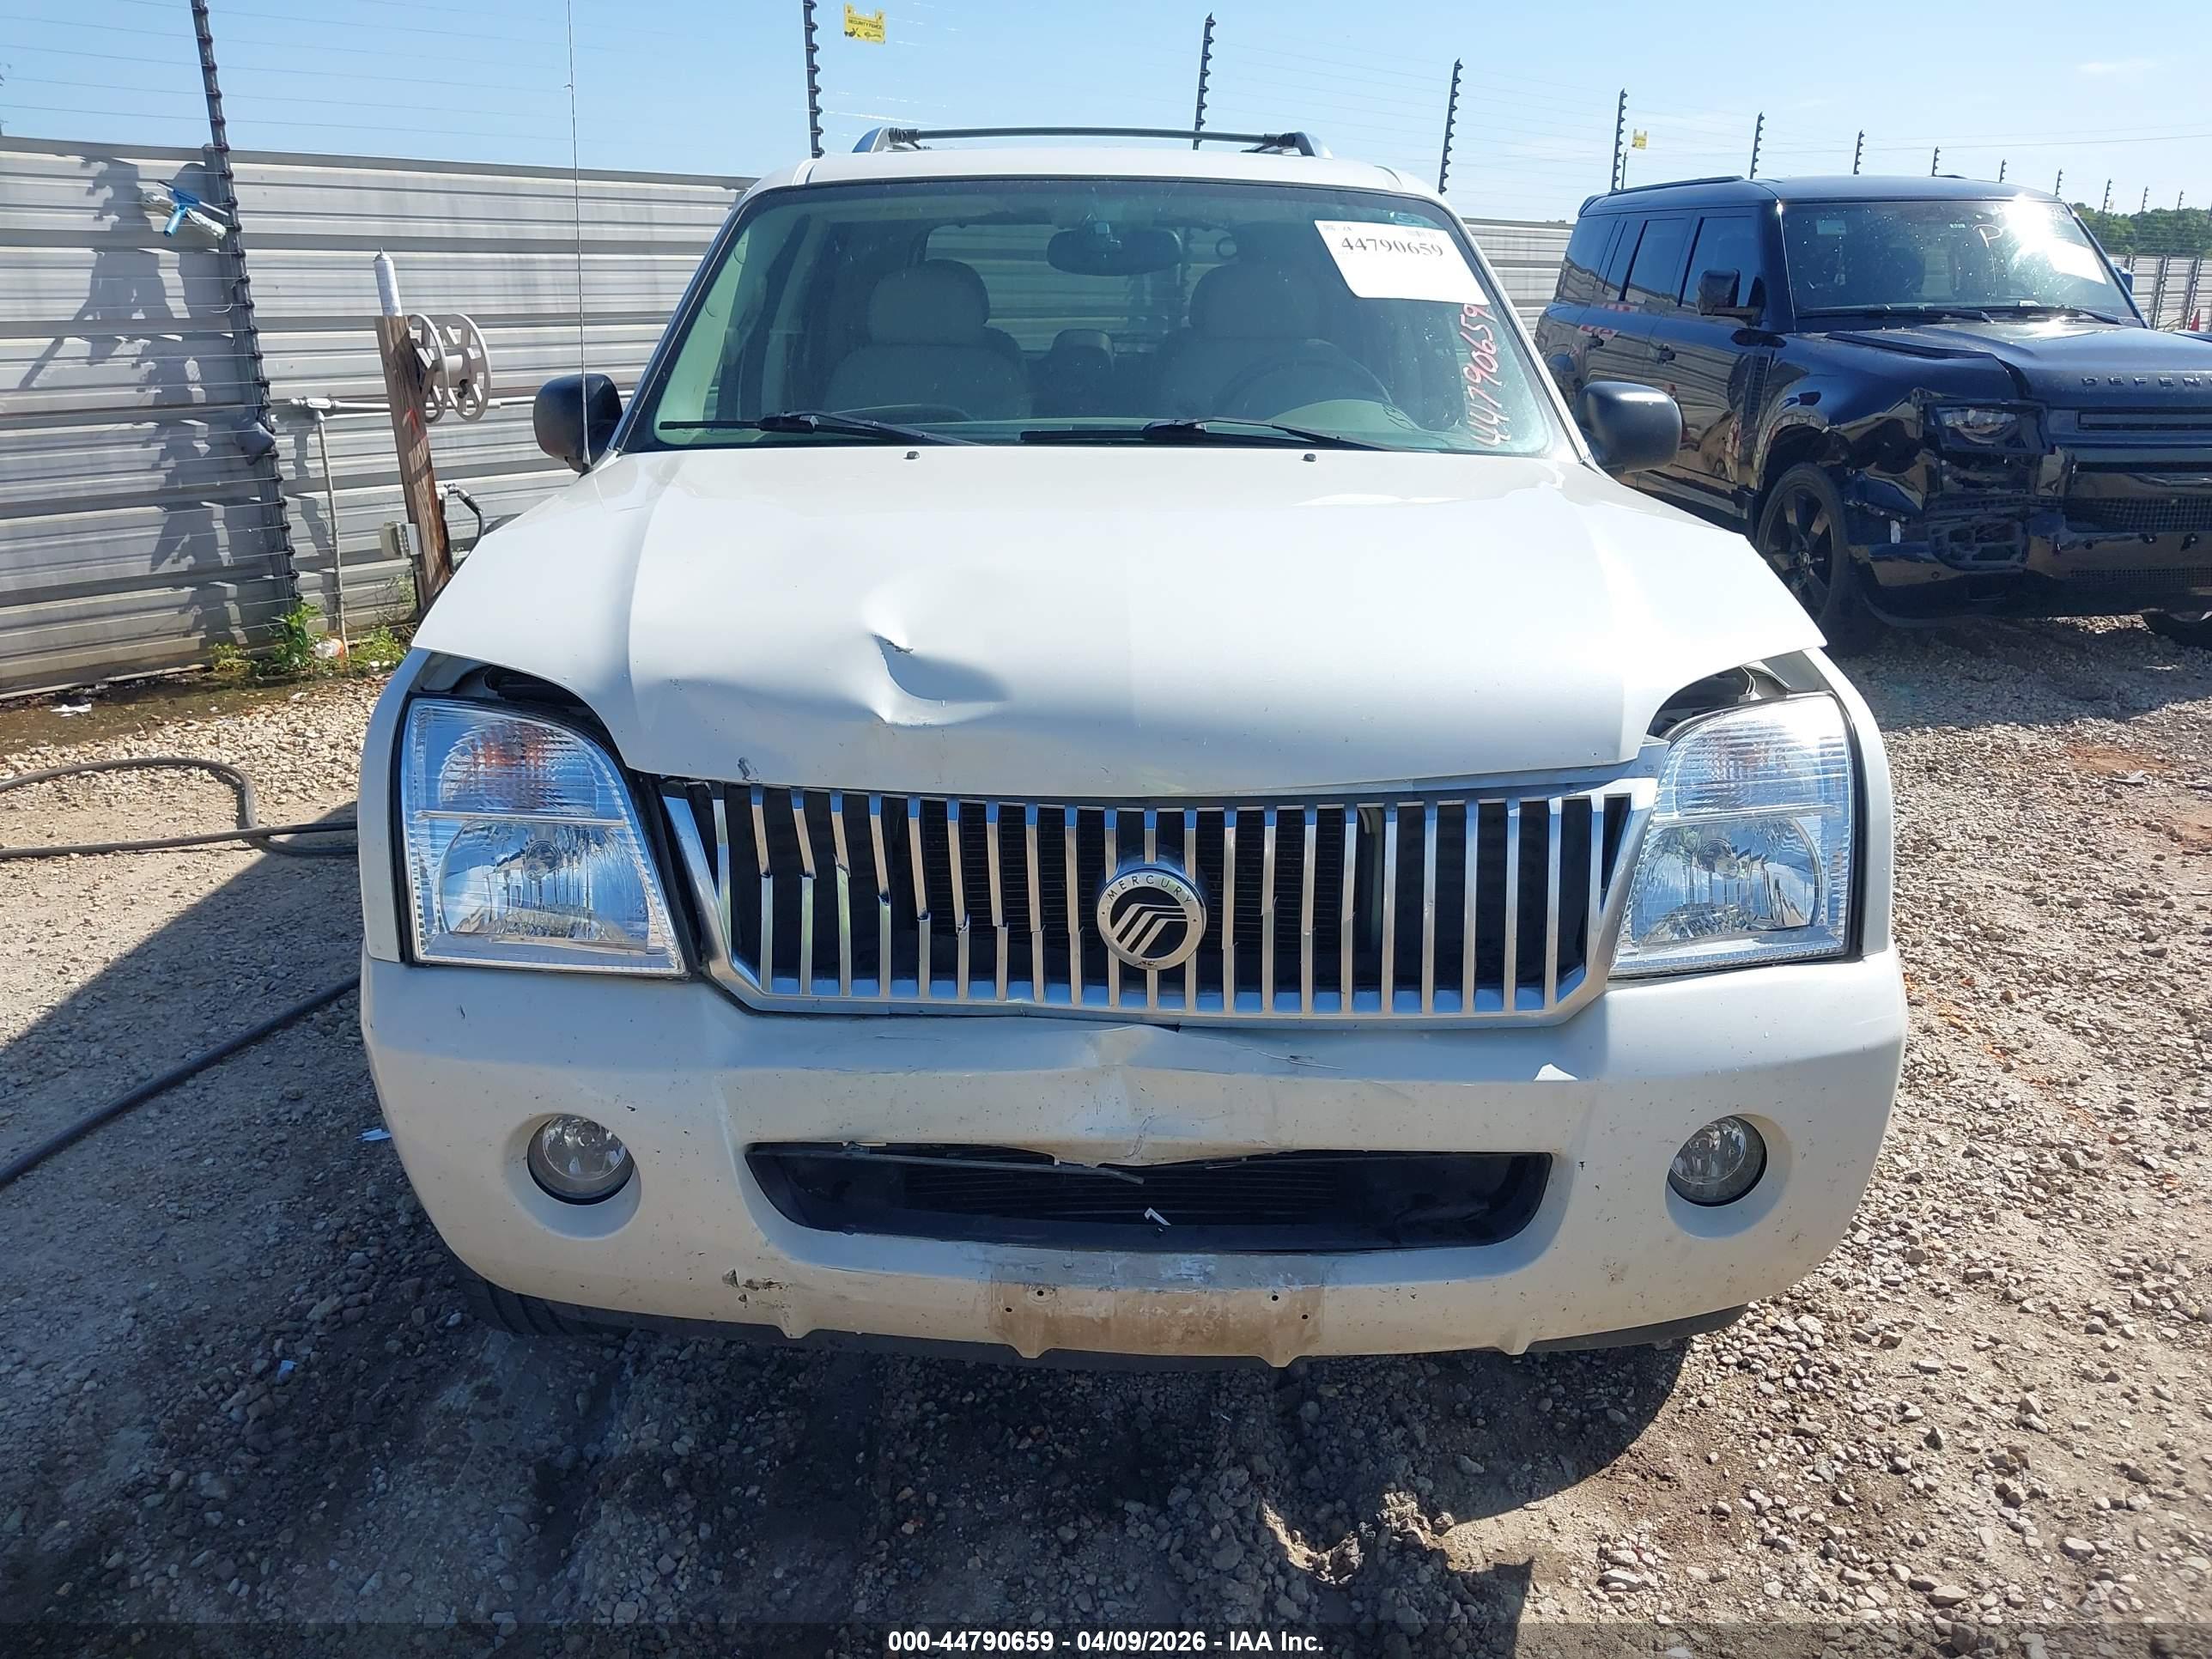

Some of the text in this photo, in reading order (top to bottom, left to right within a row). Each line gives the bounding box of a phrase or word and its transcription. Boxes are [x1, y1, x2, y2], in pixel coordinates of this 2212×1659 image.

[1341, 236, 1443, 257] 44790659
[1459, 303, 1511, 447] 44790659
[2081, 376, 2212, 386] DEFEN
[1106, 874, 1194, 903] MERCURY
